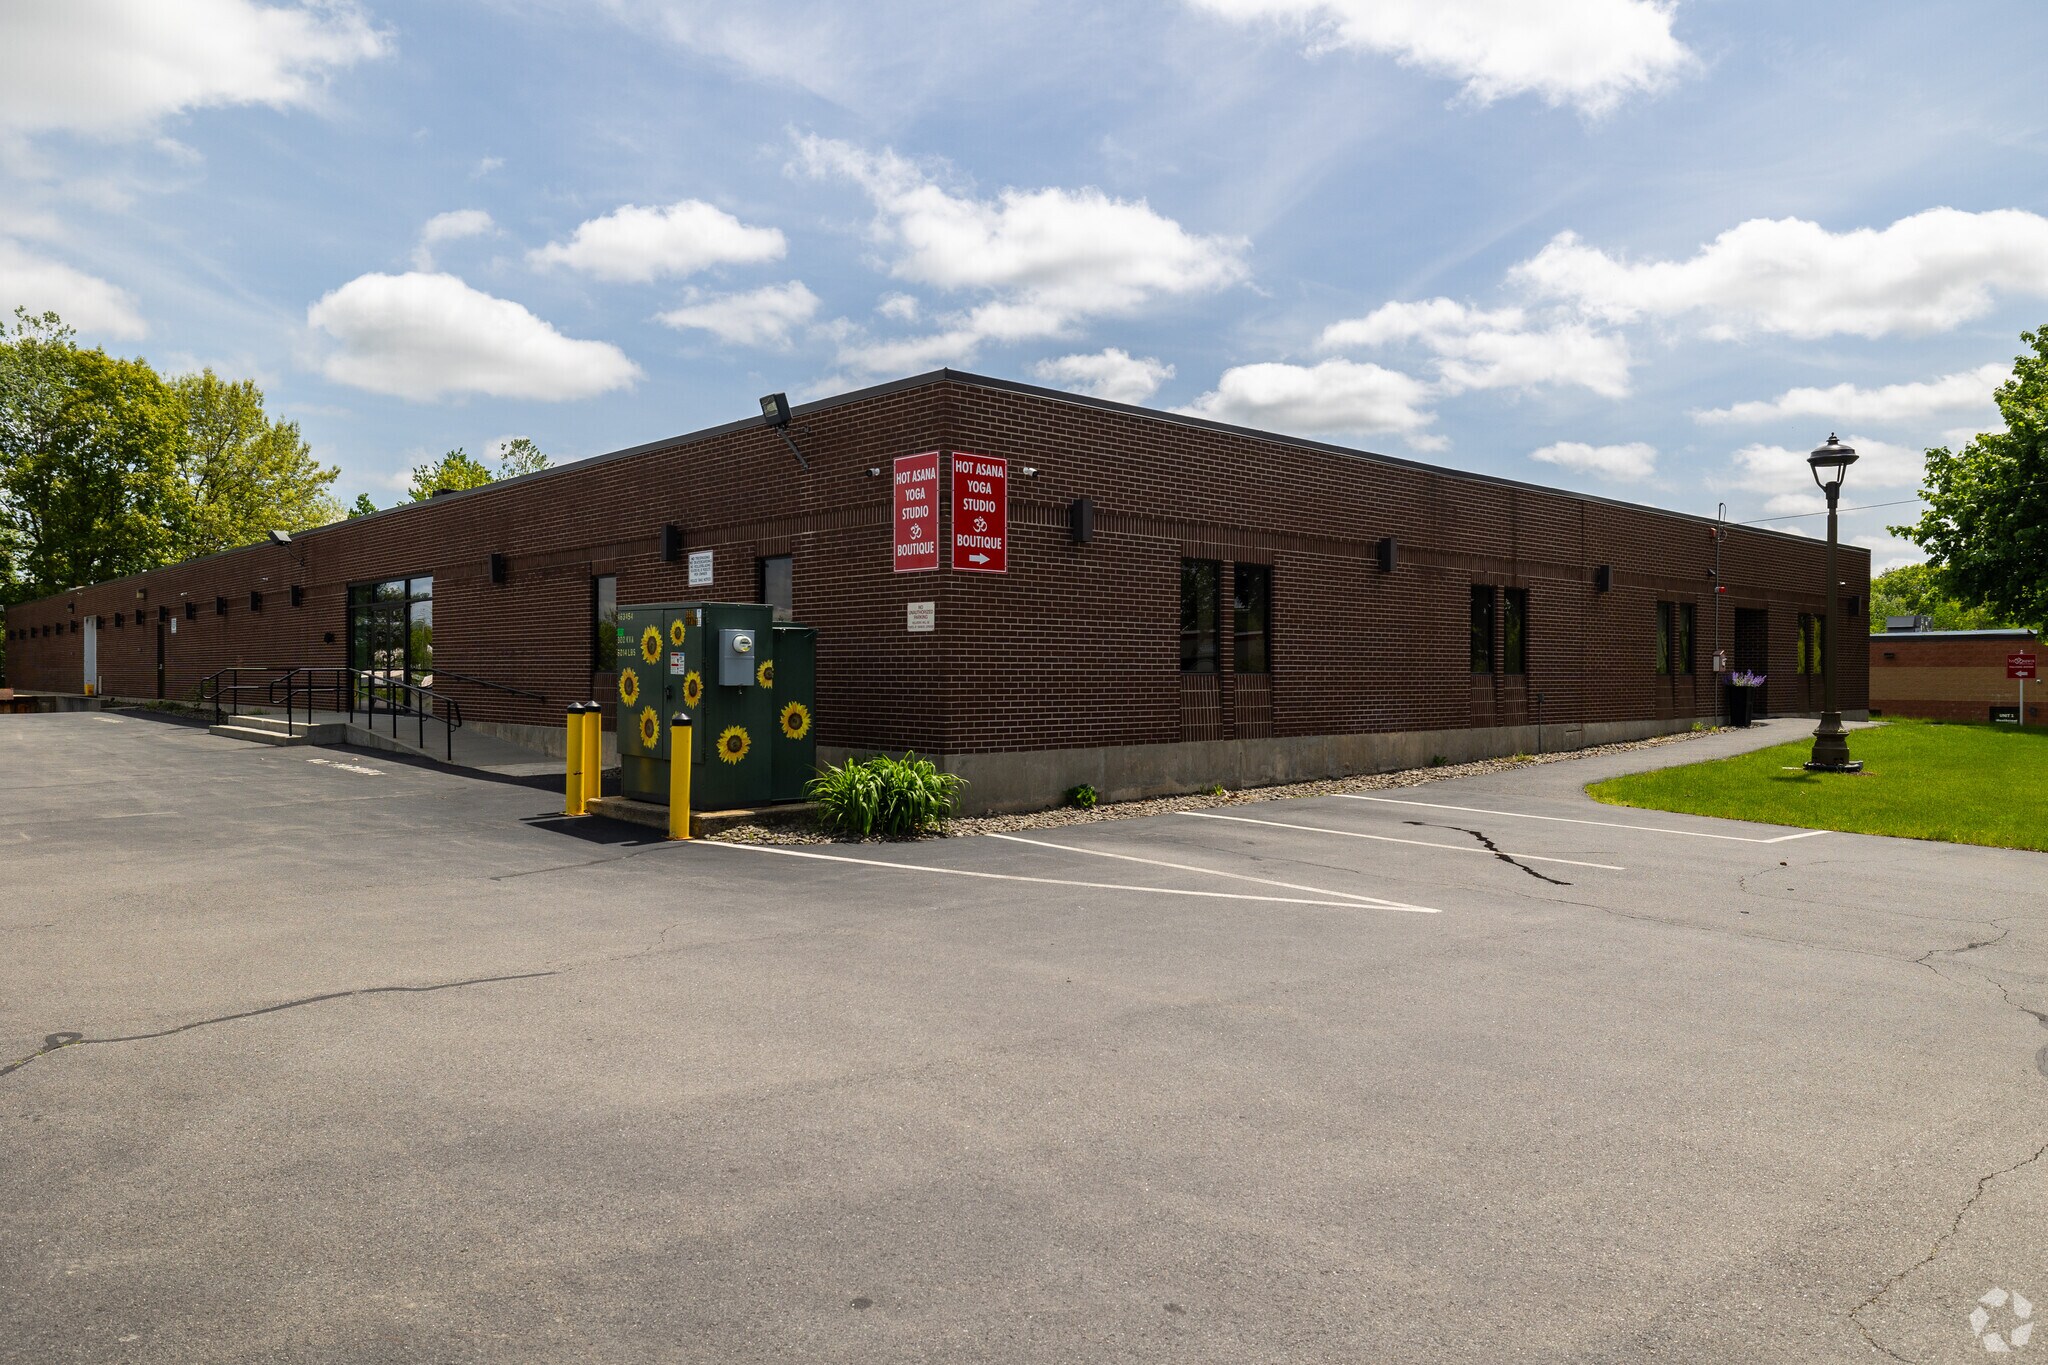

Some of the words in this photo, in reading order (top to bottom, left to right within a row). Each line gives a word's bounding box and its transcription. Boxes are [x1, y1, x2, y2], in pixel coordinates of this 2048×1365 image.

[896, 471, 910, 485] HOT
[912, 467, 936, 482] ASANA
[955, 460, 974, 474] HOT
[976, 463, 1004, 478] ASANA
[905, 487, 926, 501] YOGA
[967, 480, 992, 494] YOGA
[902, 505, 929, 520] STUDIO
[963, 498, 996, 513] STUDIO
[897, 541, 934, 557] BOUTIQUE
[957, 534, 1002, 550] BOUTIQUE
